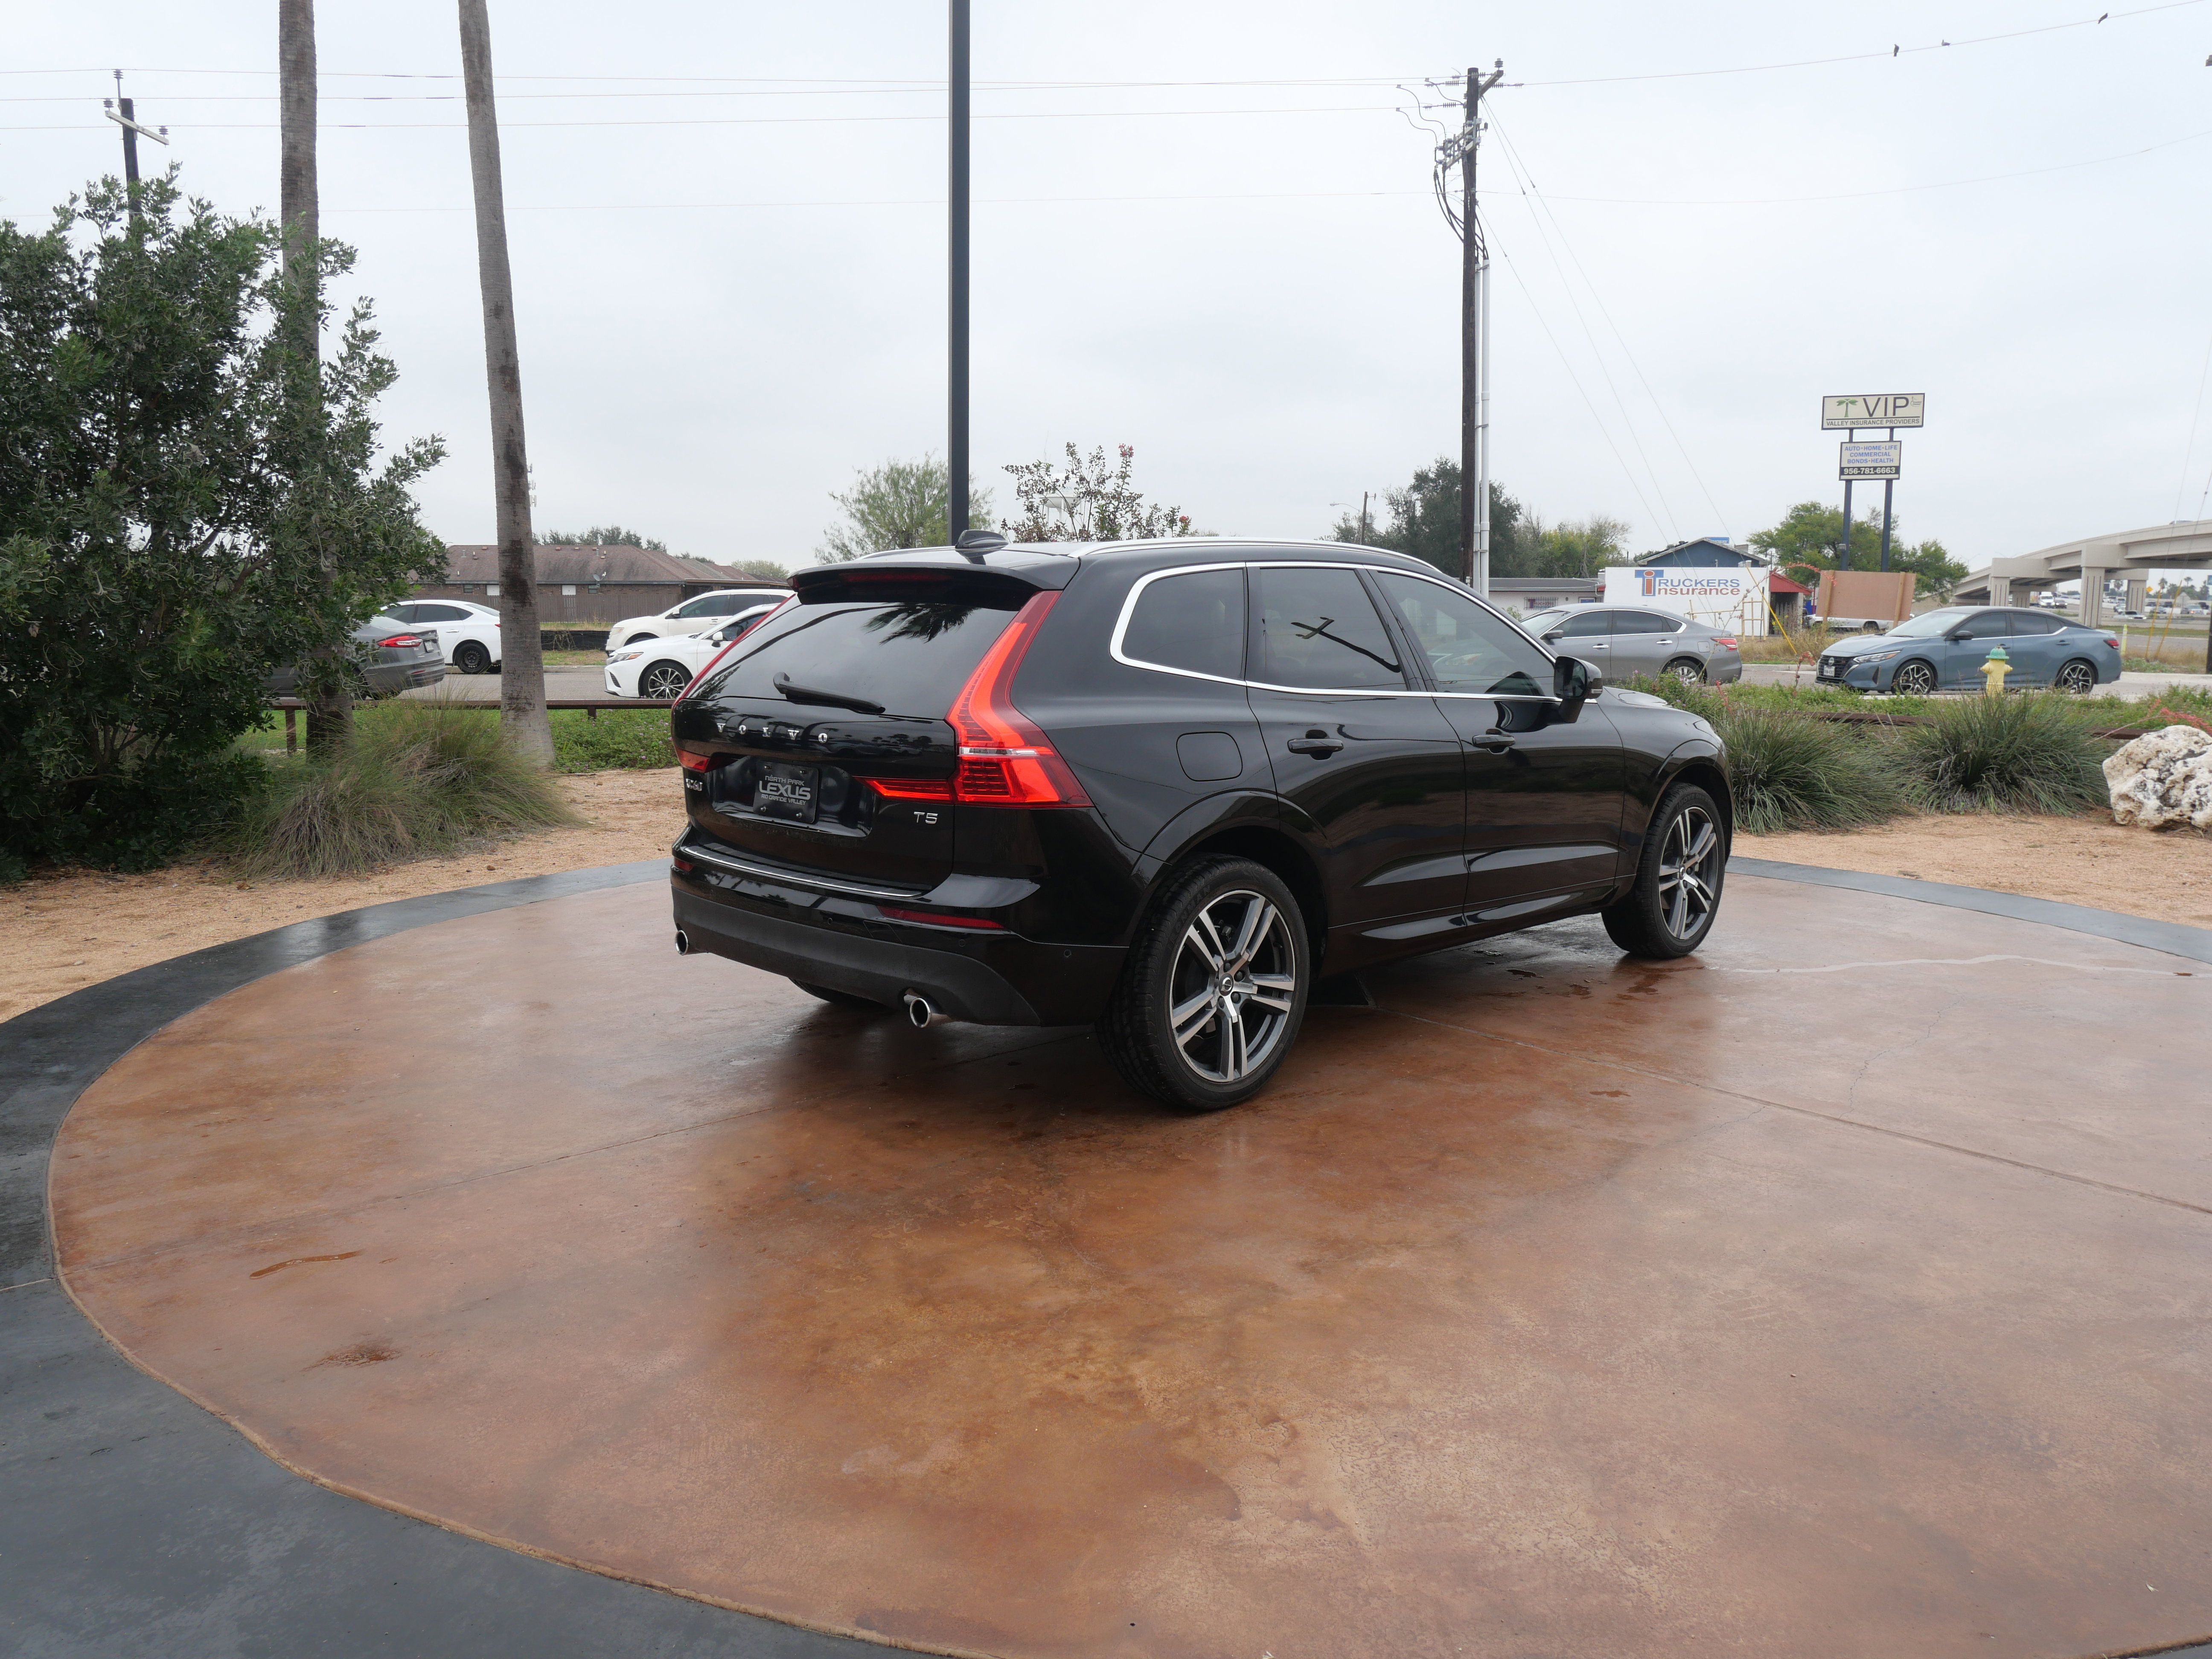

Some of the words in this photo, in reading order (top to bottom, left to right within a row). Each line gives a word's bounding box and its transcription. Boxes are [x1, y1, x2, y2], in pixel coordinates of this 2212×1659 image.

[1863, 396, 1909, 417] VIP
[716, 723, 828, 743] VOLVO
[759, 780, 811, 800] LEXUS
[914, 812, 938, 824] T5
